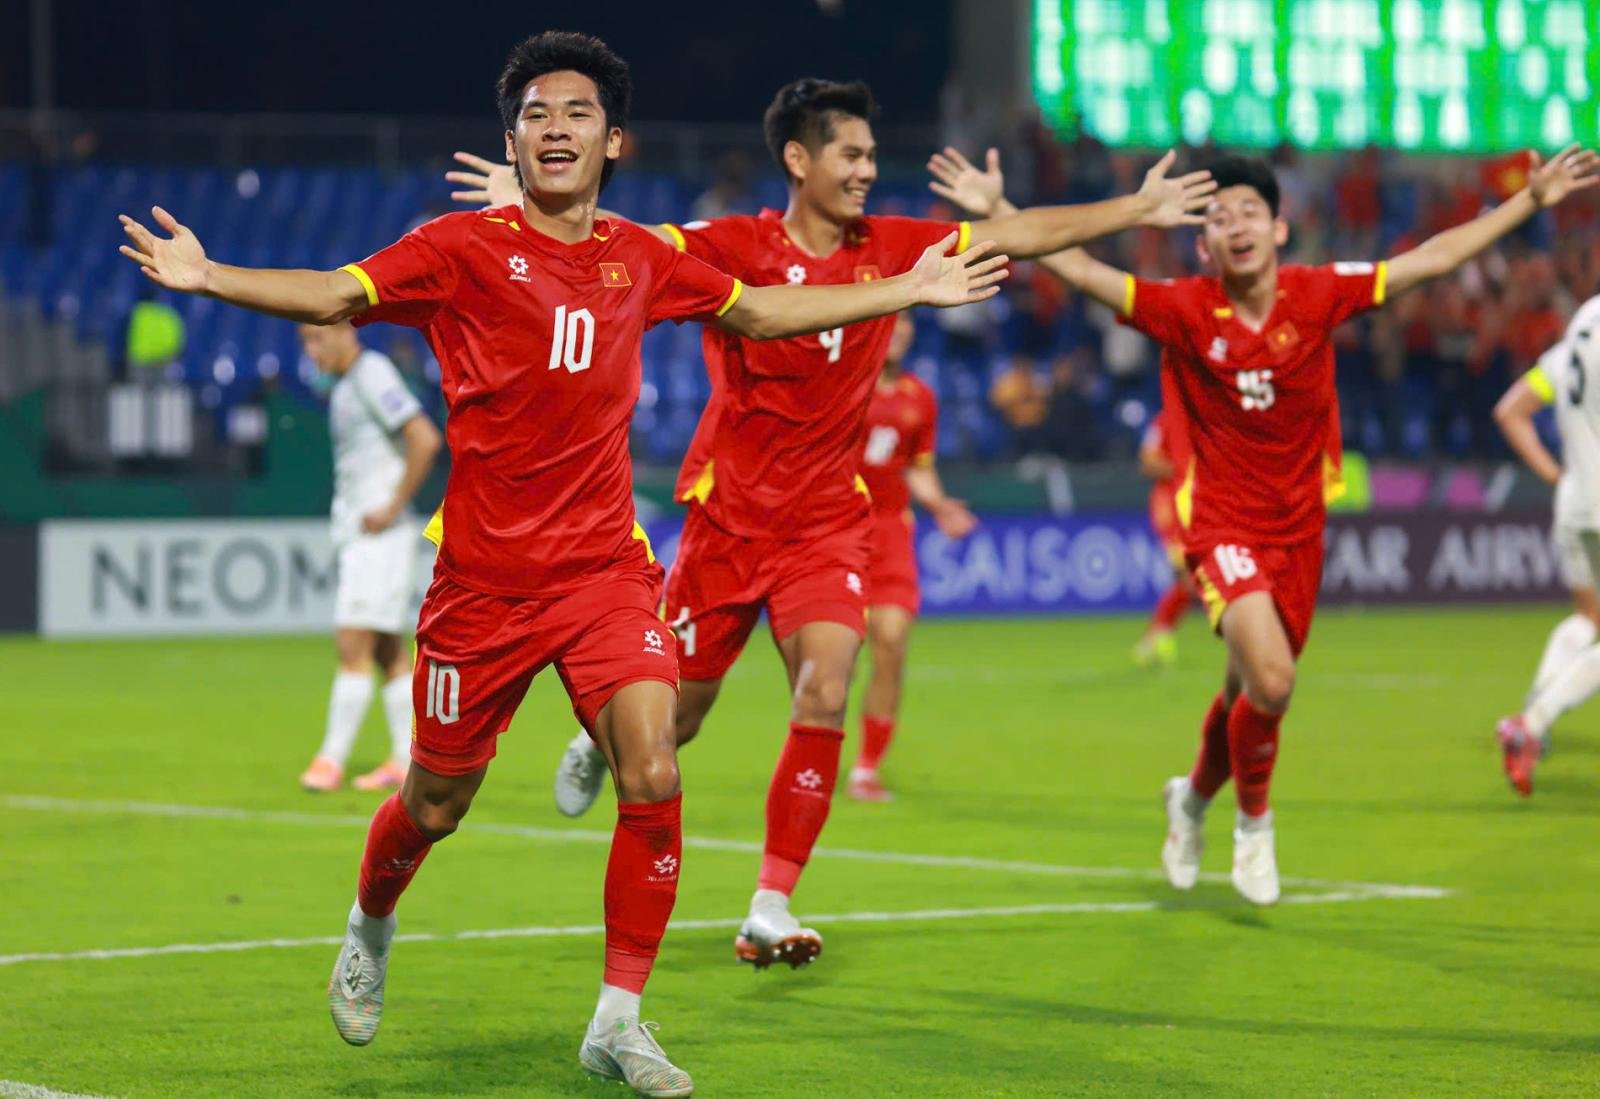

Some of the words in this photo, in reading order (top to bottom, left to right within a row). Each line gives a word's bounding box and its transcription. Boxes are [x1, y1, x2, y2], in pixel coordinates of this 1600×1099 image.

[548, 304, 595, 374] 10
[90, 538, 338, 617] NEOM
[1214, 544, 1258, 586] 16
[426, 658, 460, 725] 10
